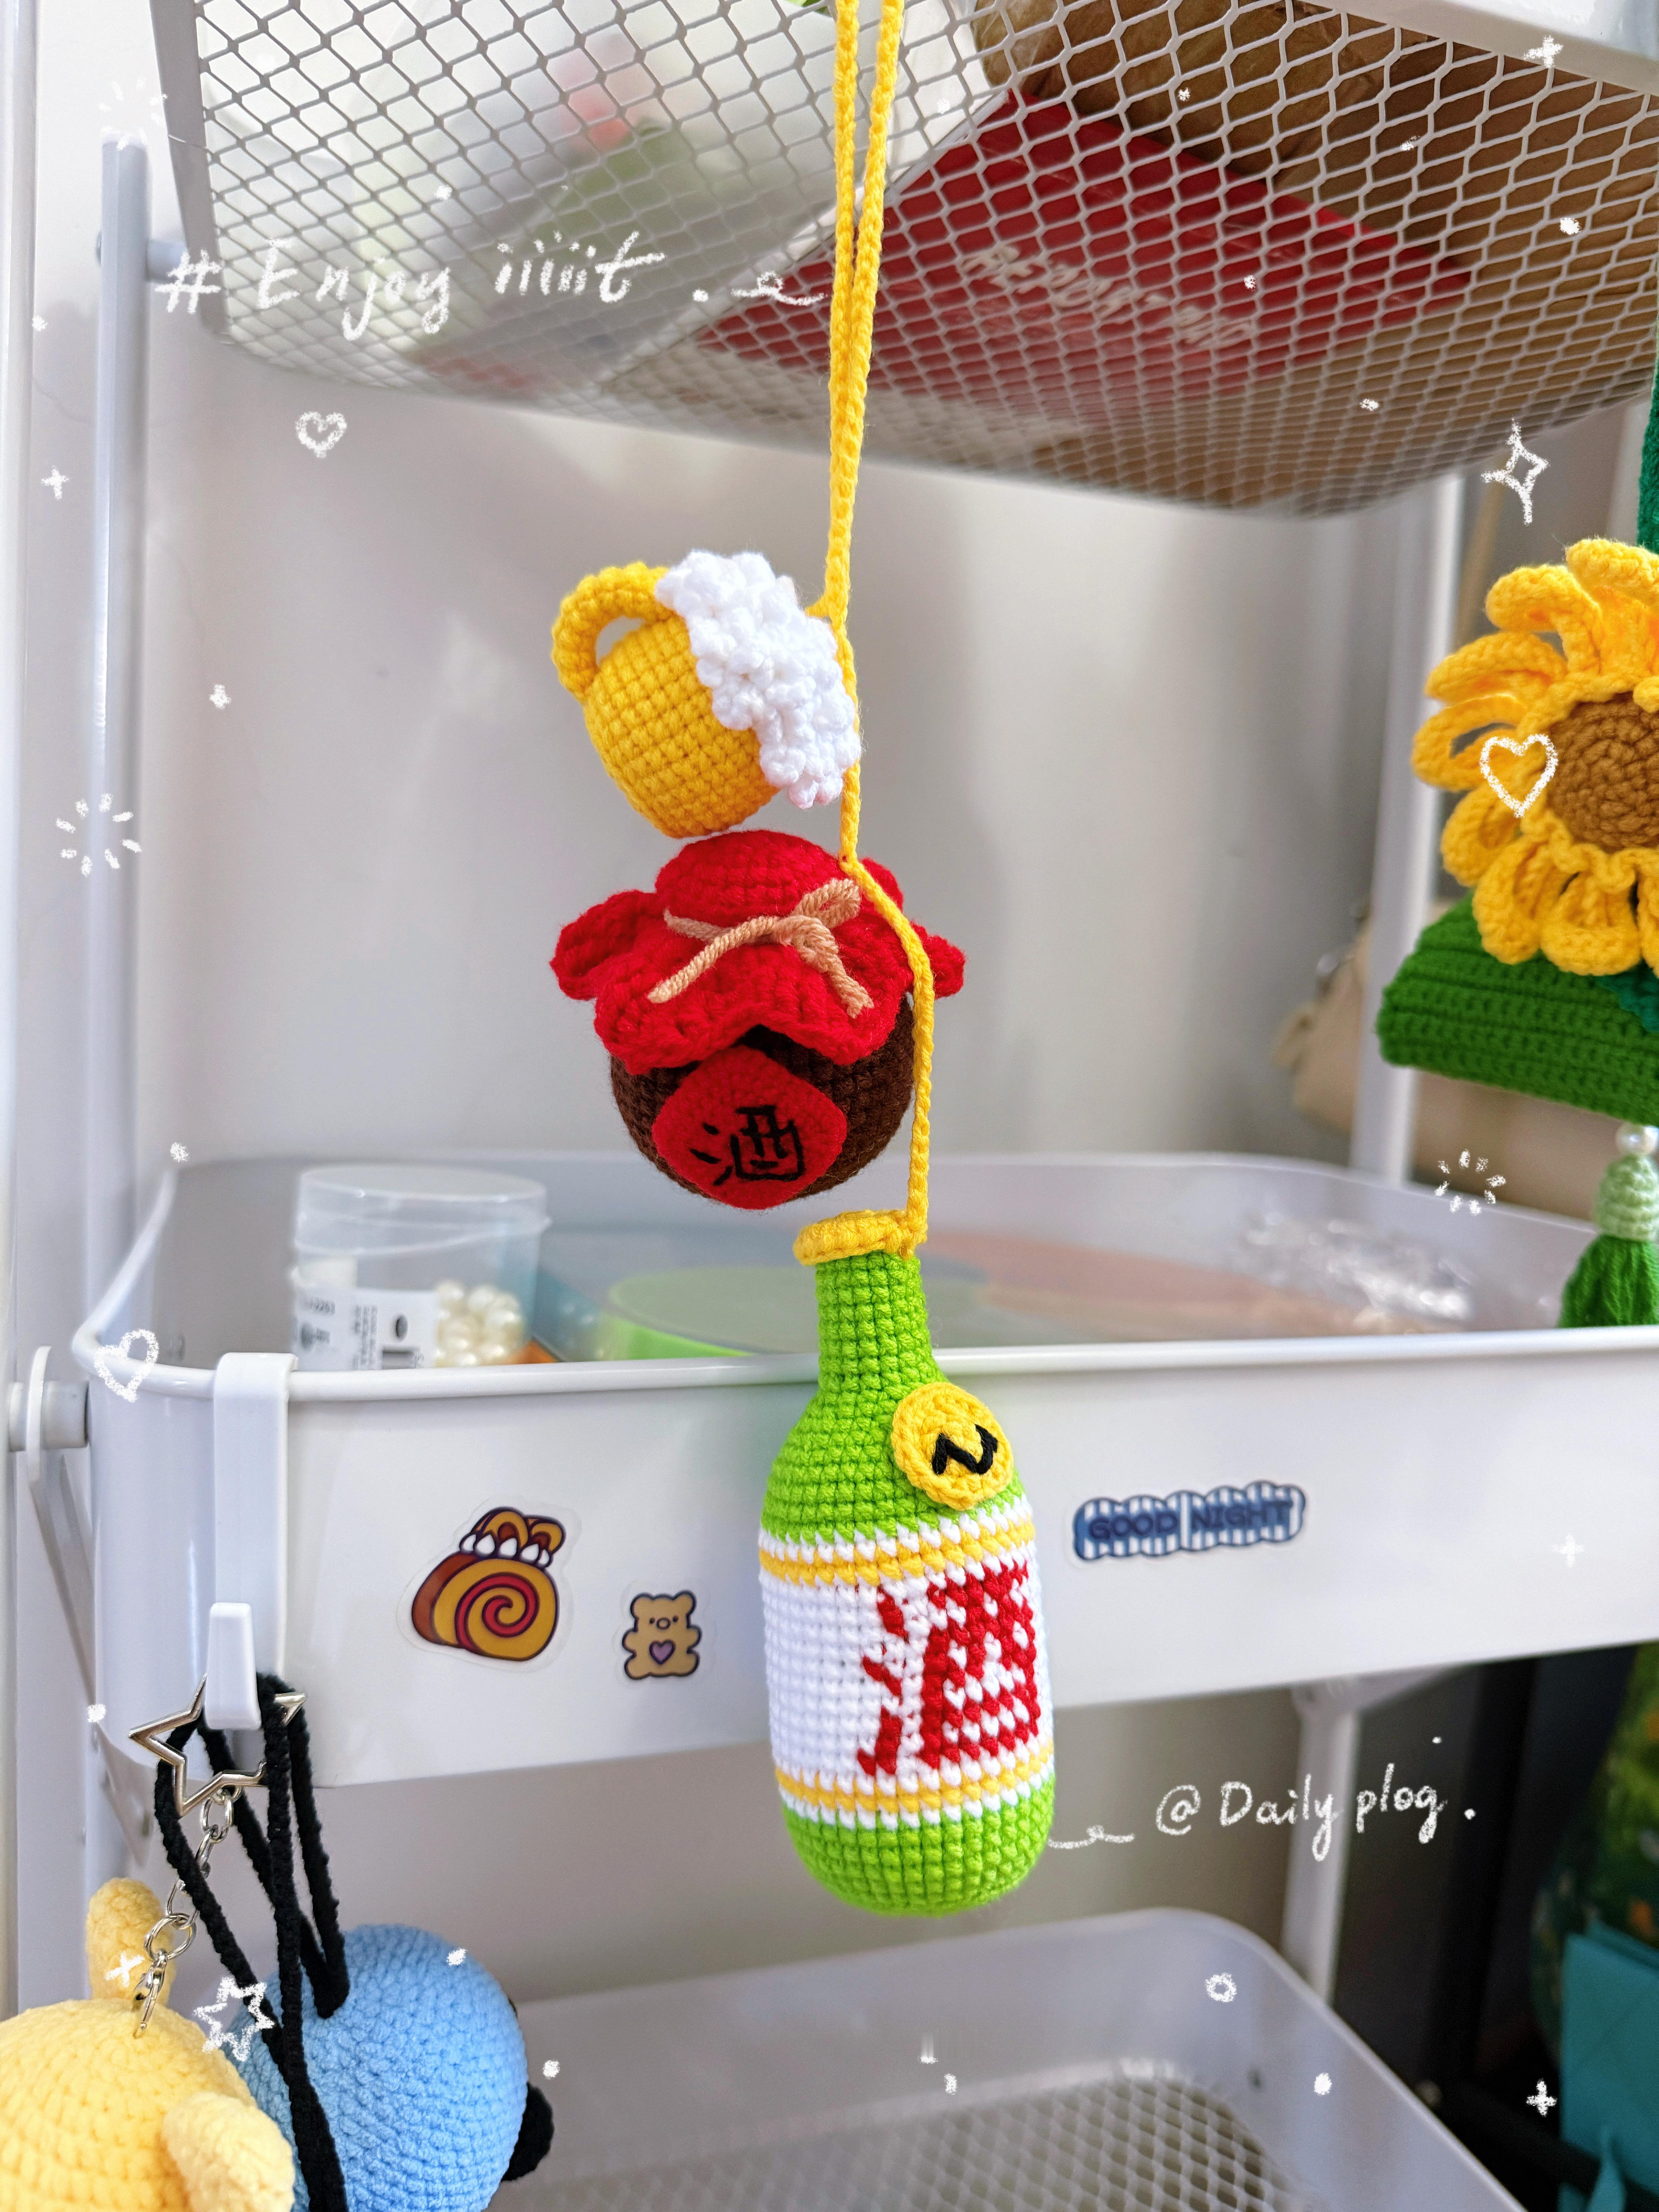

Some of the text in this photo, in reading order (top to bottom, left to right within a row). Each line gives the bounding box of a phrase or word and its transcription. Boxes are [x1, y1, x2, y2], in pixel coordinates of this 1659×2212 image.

[689, 1104, 806, 1186] 酒
[1089, 1500, 1293, 1540] GOOD NIGHT
